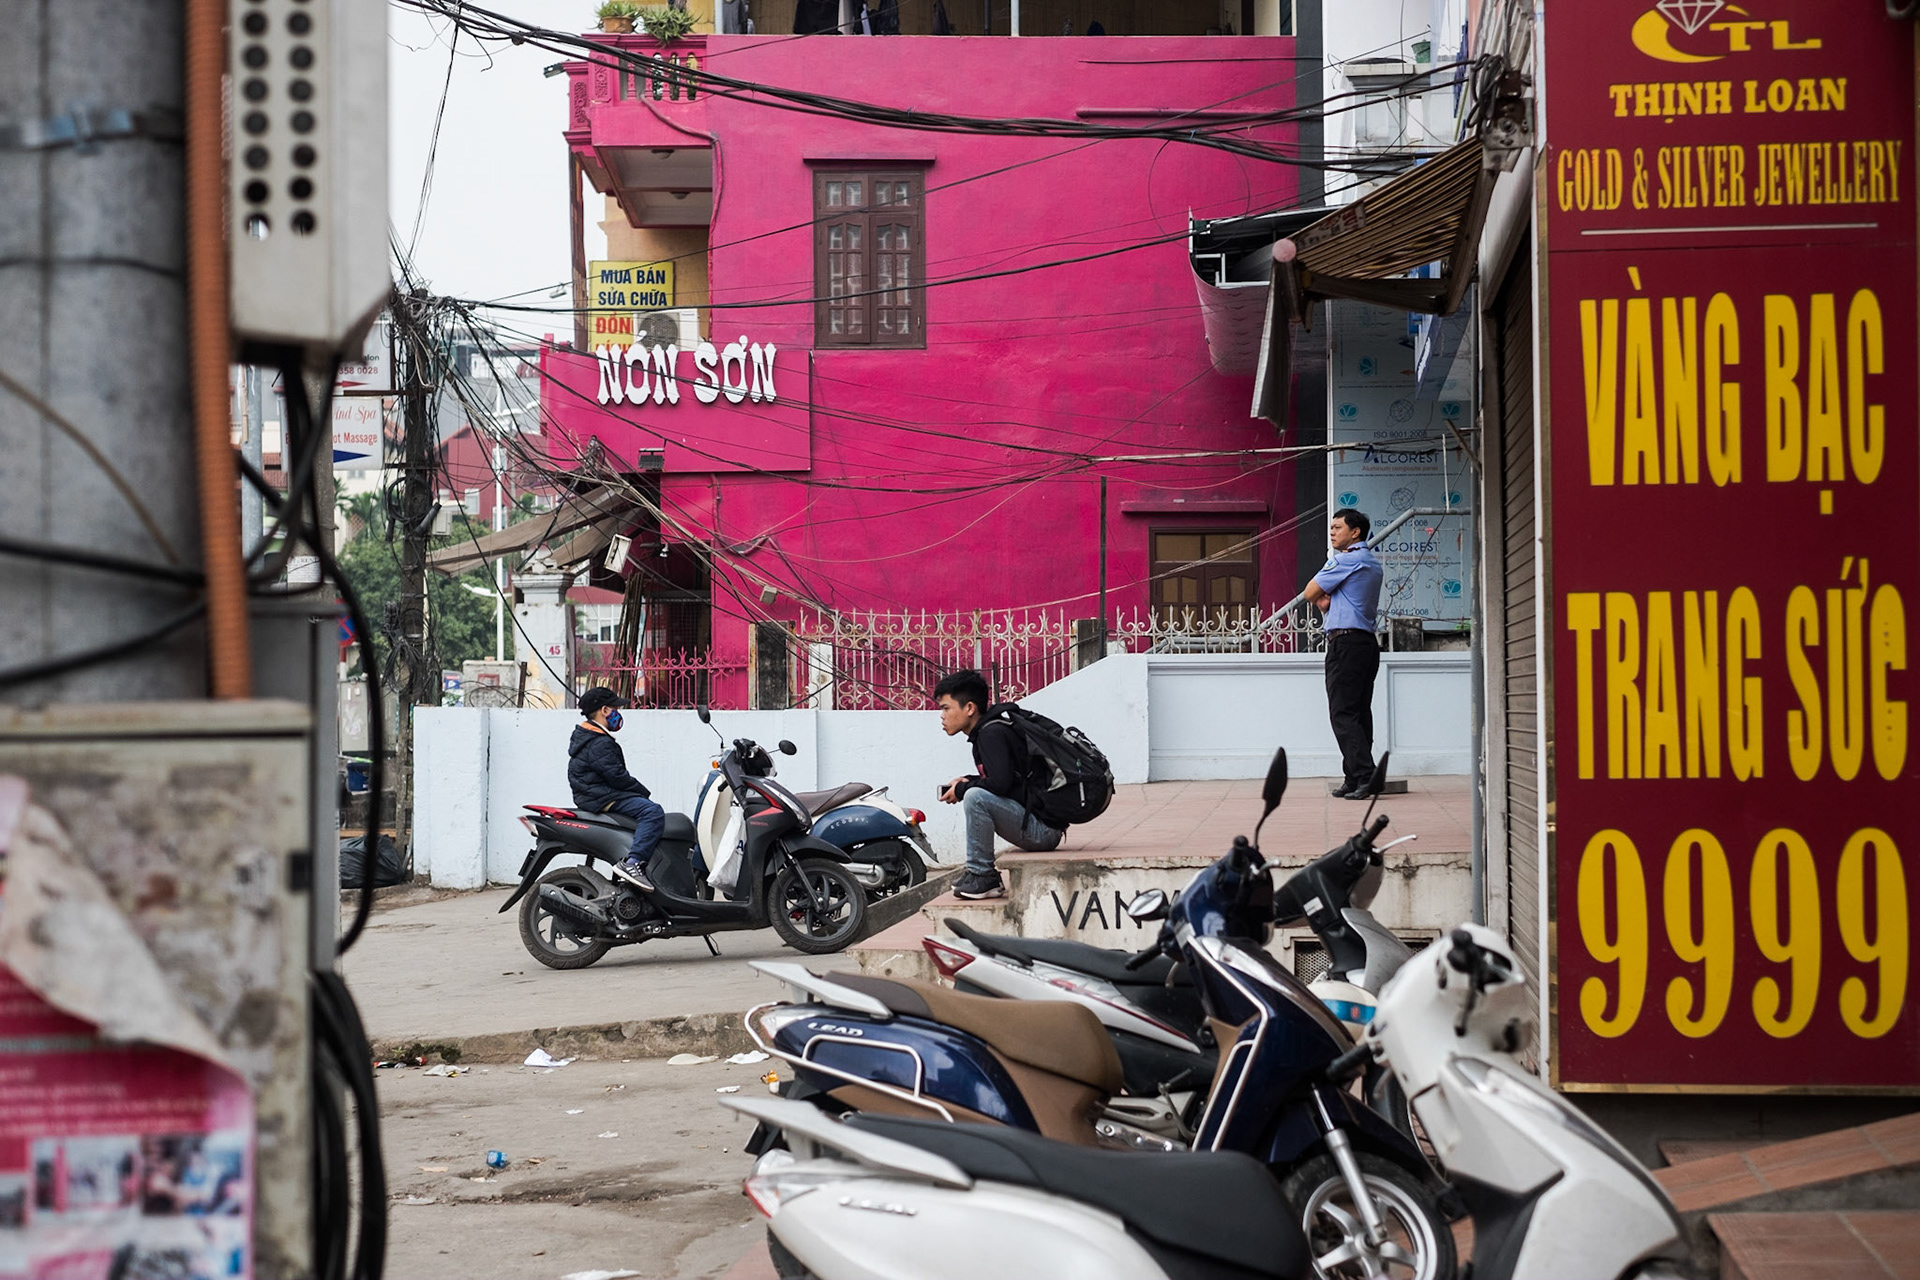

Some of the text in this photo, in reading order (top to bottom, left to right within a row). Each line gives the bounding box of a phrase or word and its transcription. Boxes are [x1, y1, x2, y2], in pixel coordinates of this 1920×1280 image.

[1609, 77, 1847, 124] THỊNH LOAN
[1557, 140, 1902, 212] GOLD & SILVER JEWELLERY
[601, 266, 666, 285] MUA BÁN
[598, 287, 668, 306] SỬA CHỮA
[357, 366, 379, 375] 0028
[595, 330, 777, 405] NÓN SƠN
[1579, 266, 1886, 515] VÀNG BẠC
[354, 404, 377, 424] Spa
[344, 432, 378, 446] Massage
[1363, 444, 1440, 464] ALCOREST
[549, 645, 561, 656] 45
[1567, 556, 1908, 782] TRANG SỨC
[1577, 827, 1909, 1039] 9999
[807, 1022, 864, 1037] LEAD
